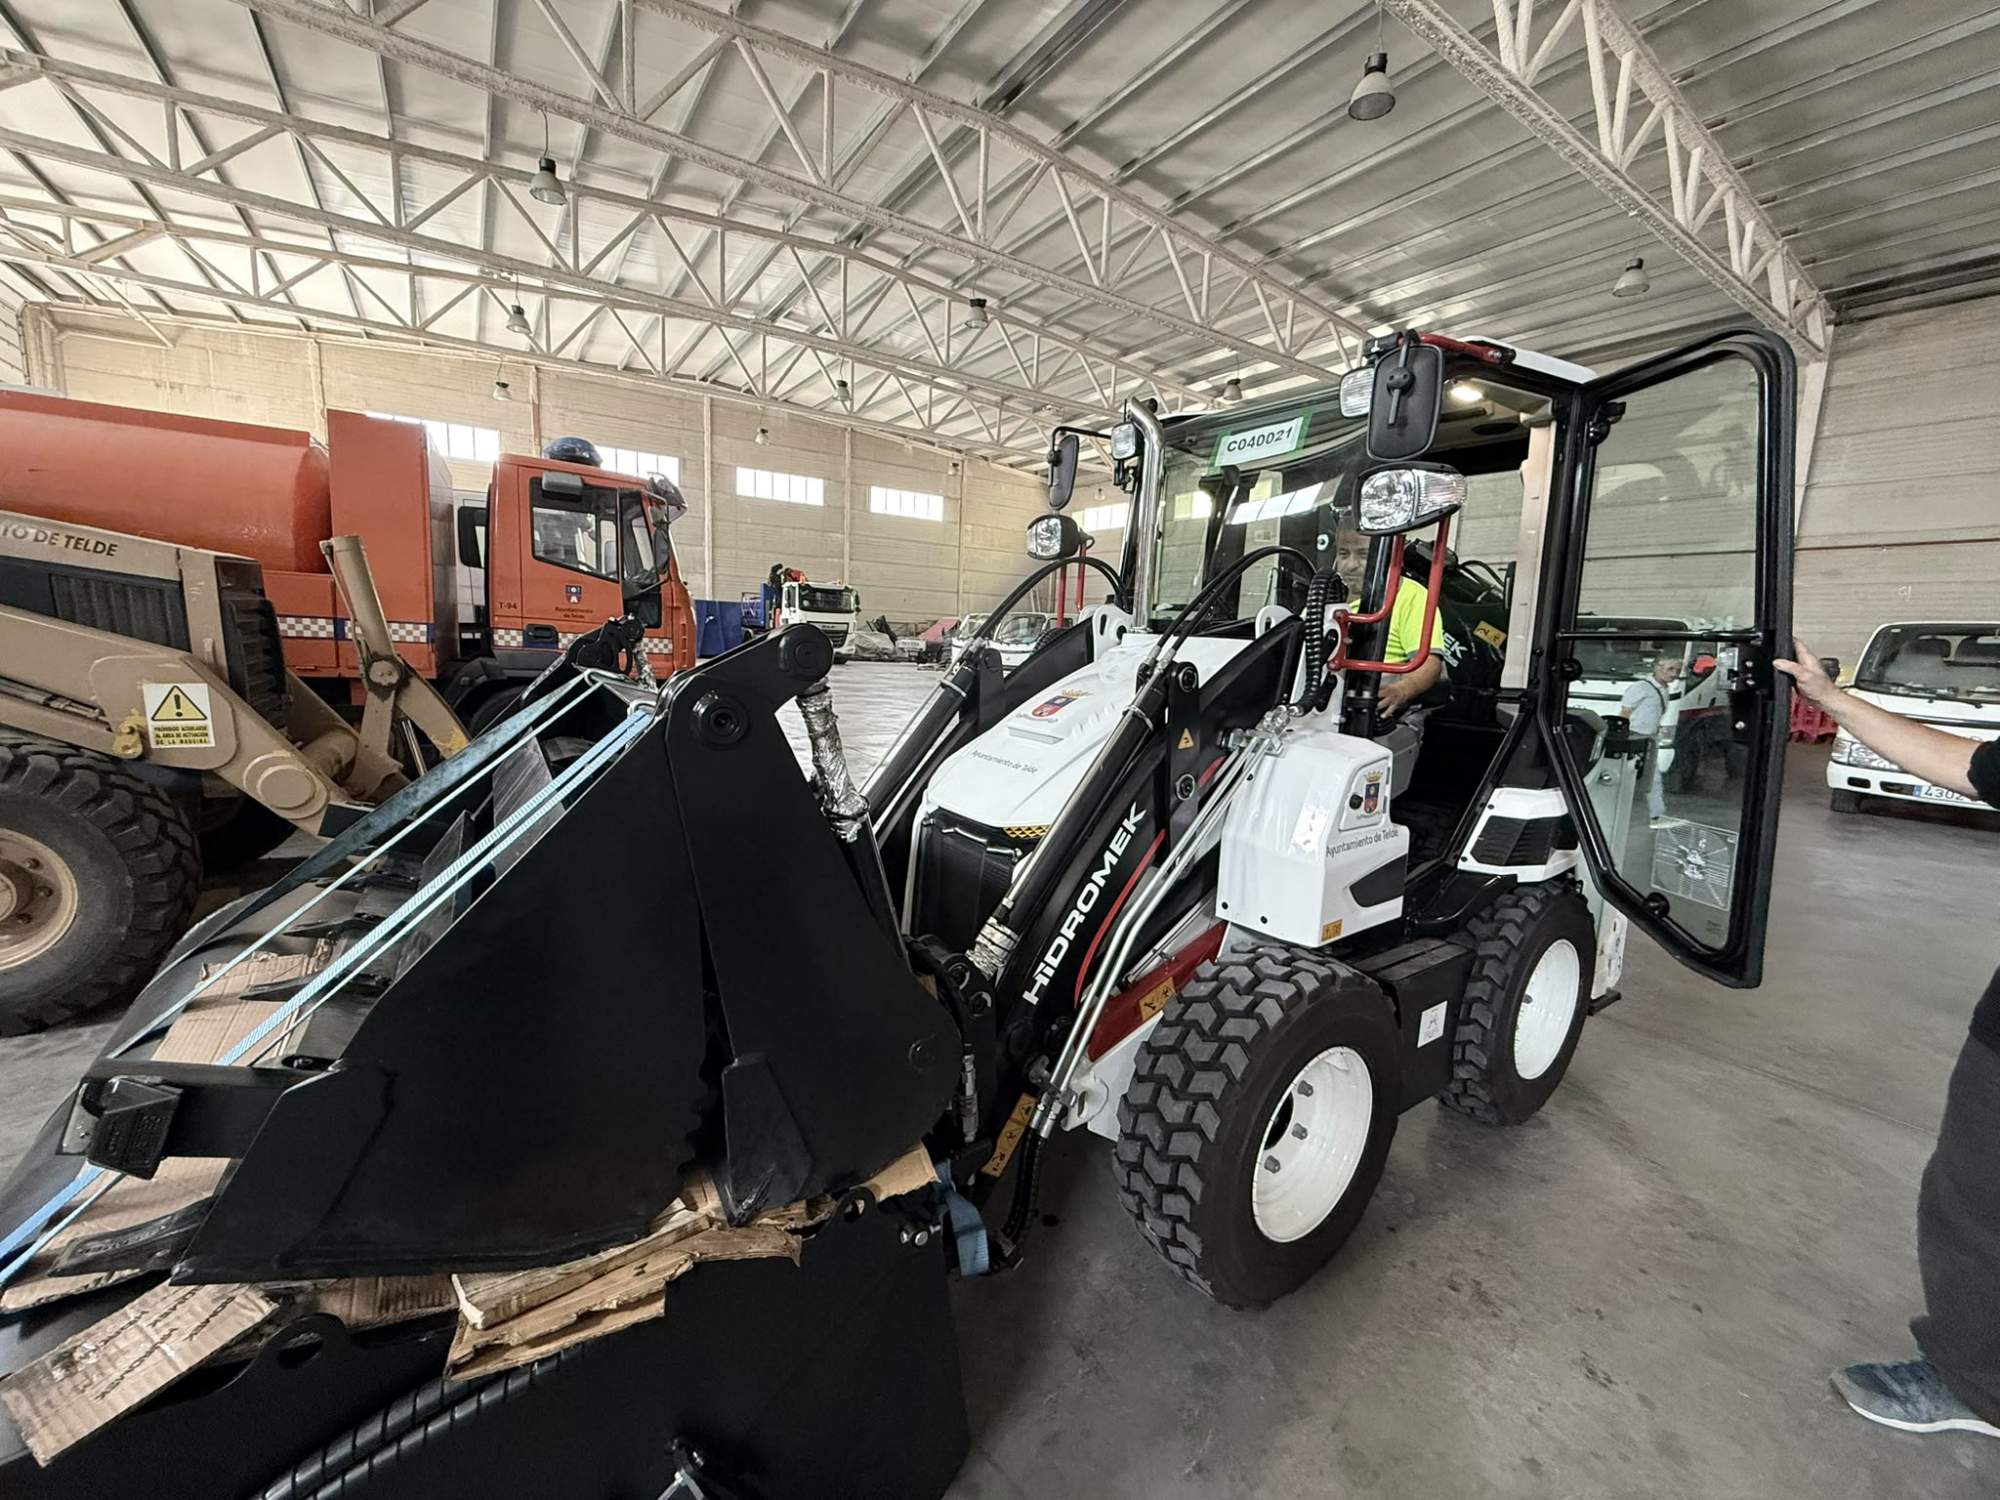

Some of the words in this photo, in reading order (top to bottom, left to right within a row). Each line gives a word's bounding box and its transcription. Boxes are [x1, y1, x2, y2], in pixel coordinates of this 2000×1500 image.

[1226, 426, 1293, 452] C040021
[33, 528, 60, 546] DE
[64, 535, 118, 556] TELDE
[1326, 835, 1373, 858] Ayuntamiento
[1374, 831, 1382, 842] de
[1382, 829, 1398, 841] Telde
